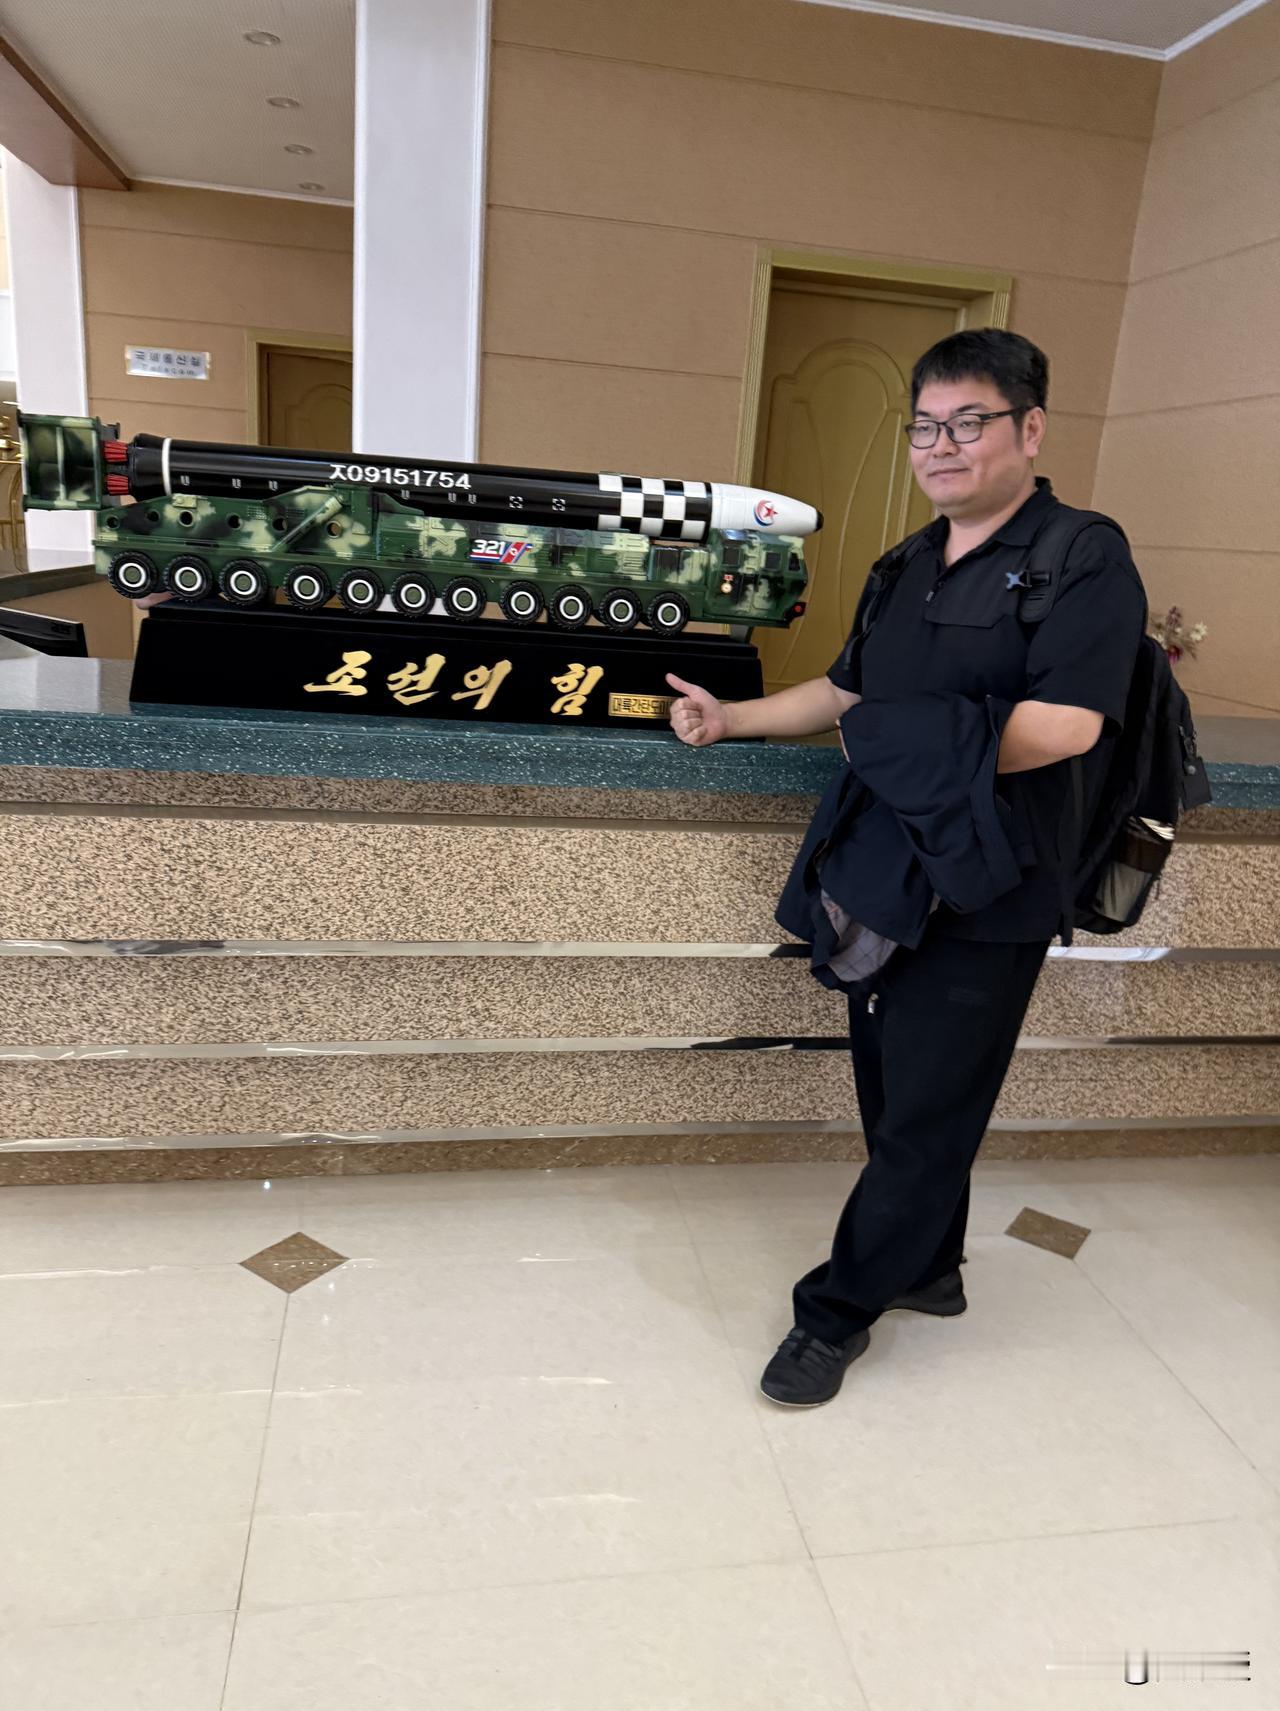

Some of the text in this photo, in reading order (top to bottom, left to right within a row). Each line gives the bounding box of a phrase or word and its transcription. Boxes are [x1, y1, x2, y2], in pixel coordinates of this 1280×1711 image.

[472, 539, 506, 555] 321
[303, 650, 604, 716] 조선의 힘
[612, 697, 674, 715] 대륙간탄도미
